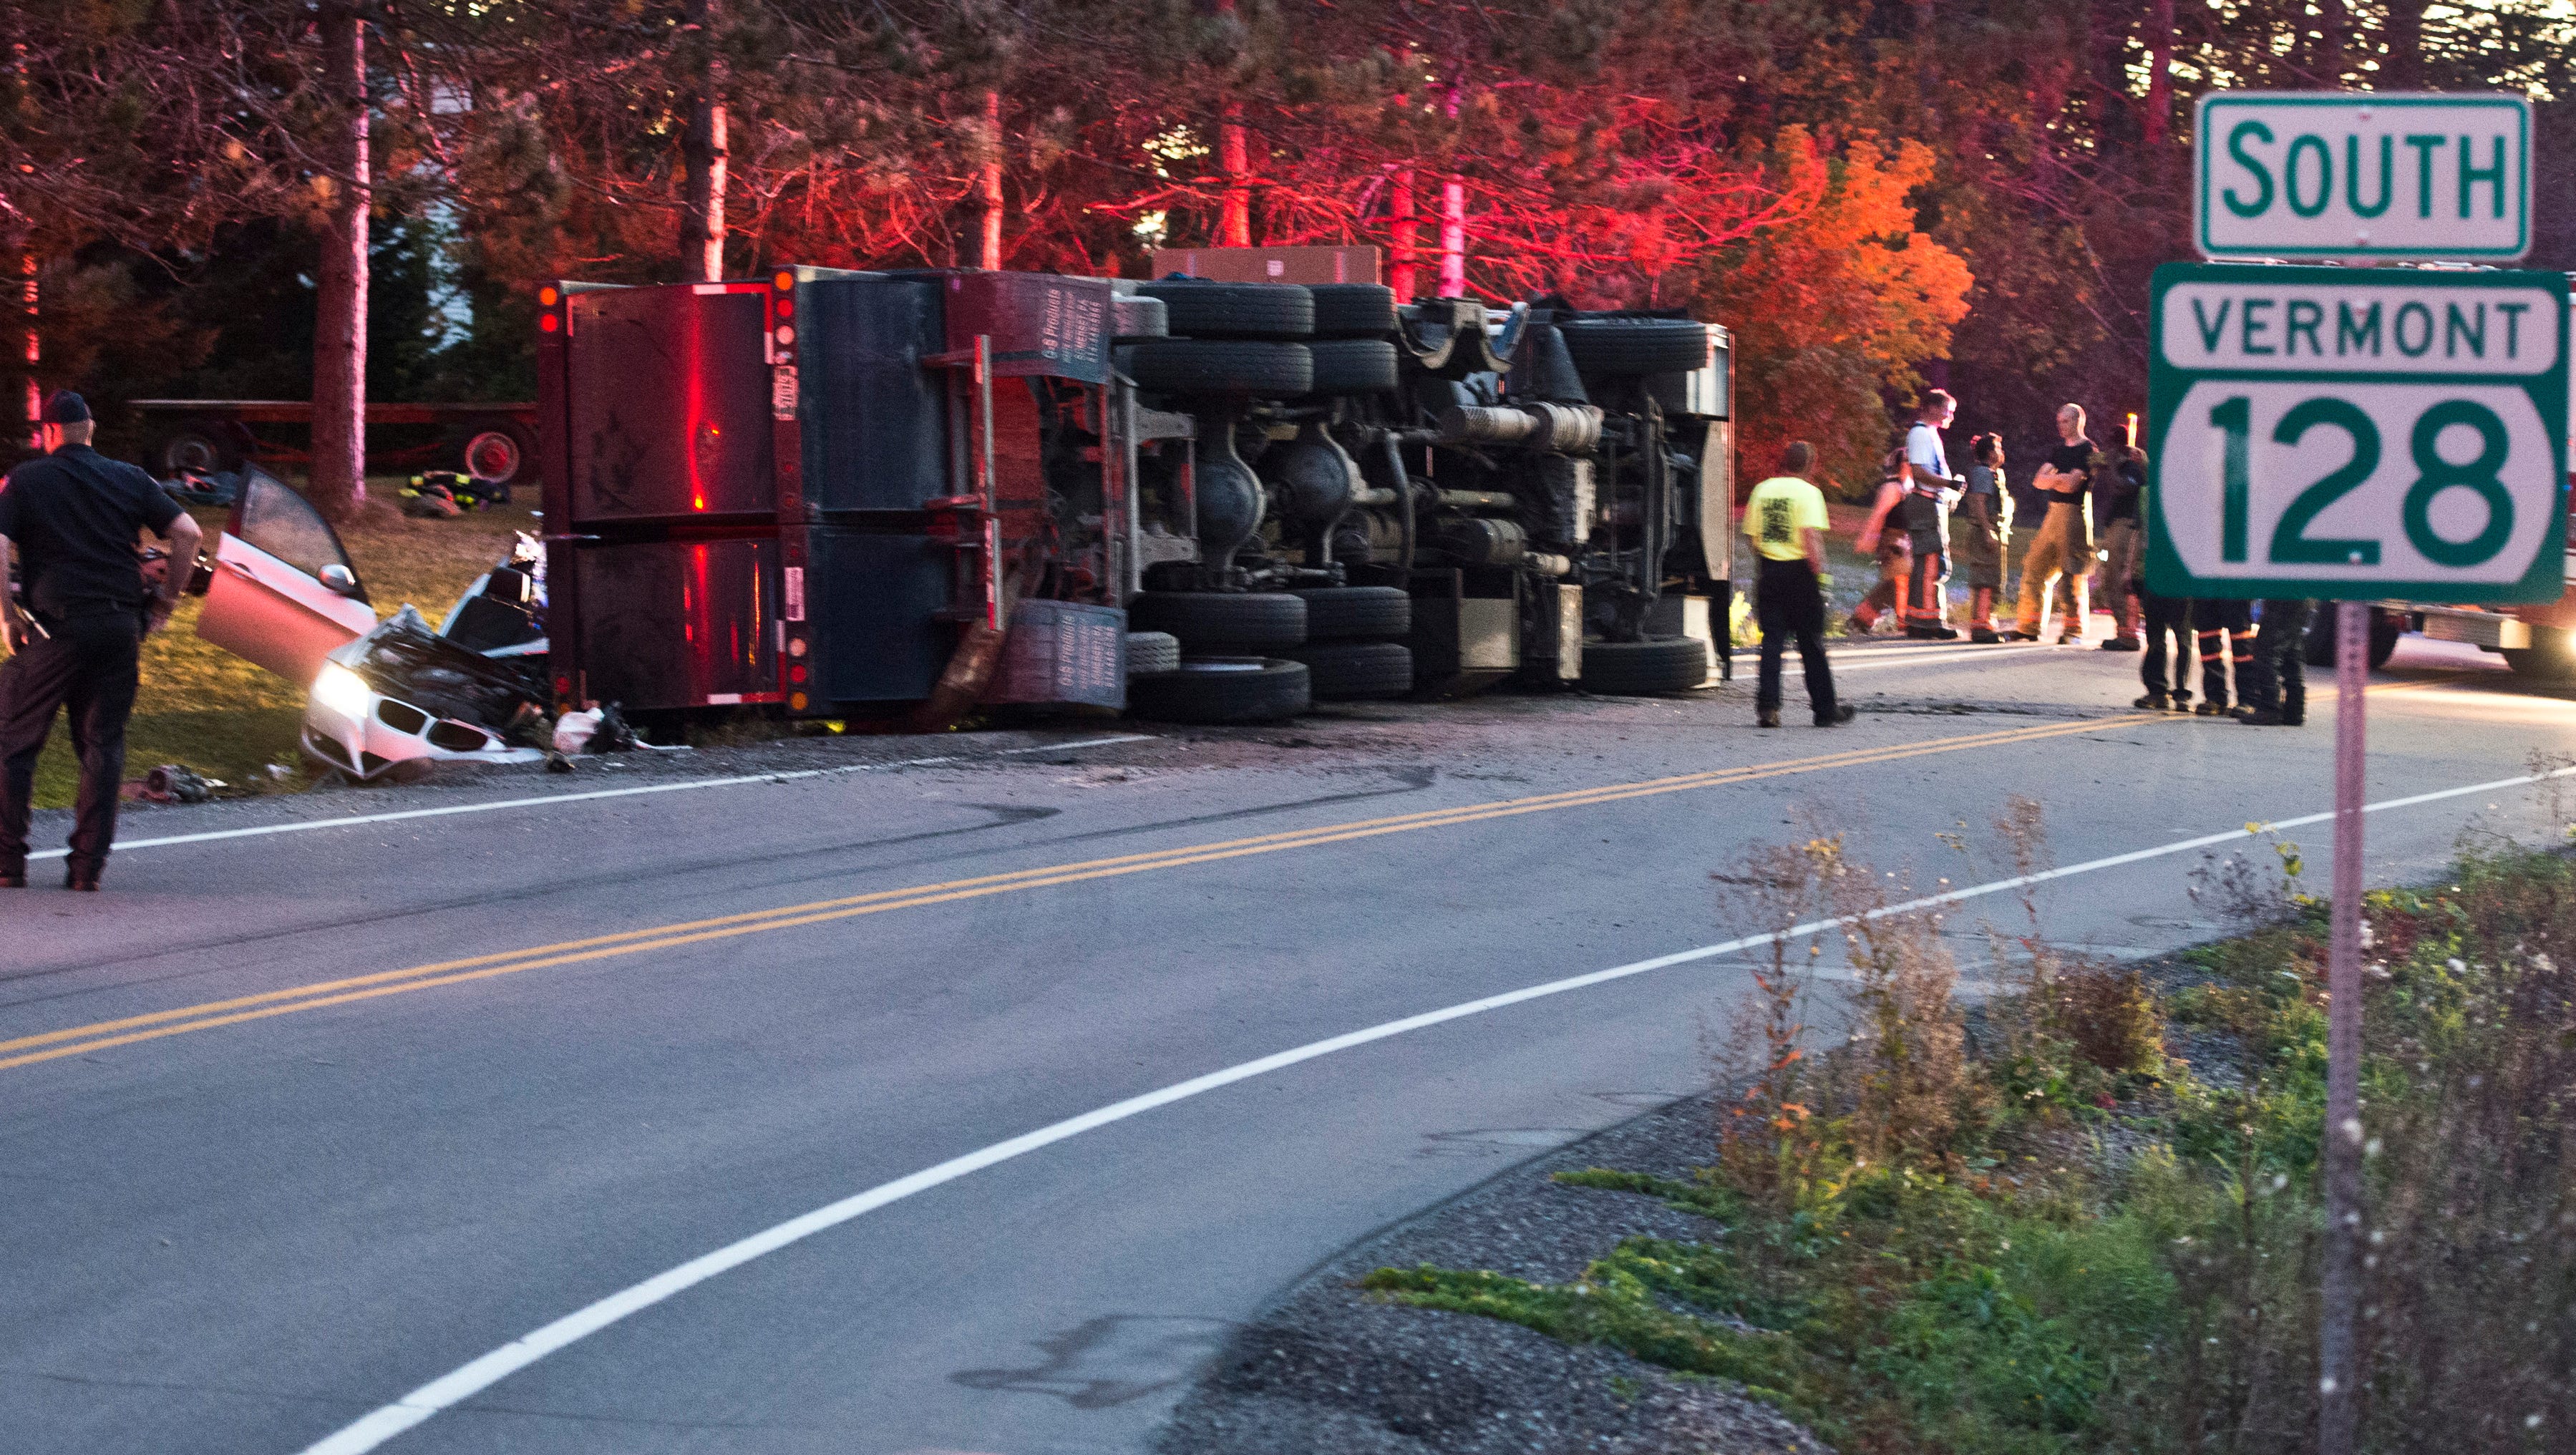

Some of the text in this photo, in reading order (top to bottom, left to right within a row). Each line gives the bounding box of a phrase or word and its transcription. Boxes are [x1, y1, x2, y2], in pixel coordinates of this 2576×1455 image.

[2222, 119, 2506, 220] SOUTH
[1042, 289, 1061, 337] Products
[2192, 297, 2530, 360] VERMONT
[2209, 395, 2516, 568] 128
